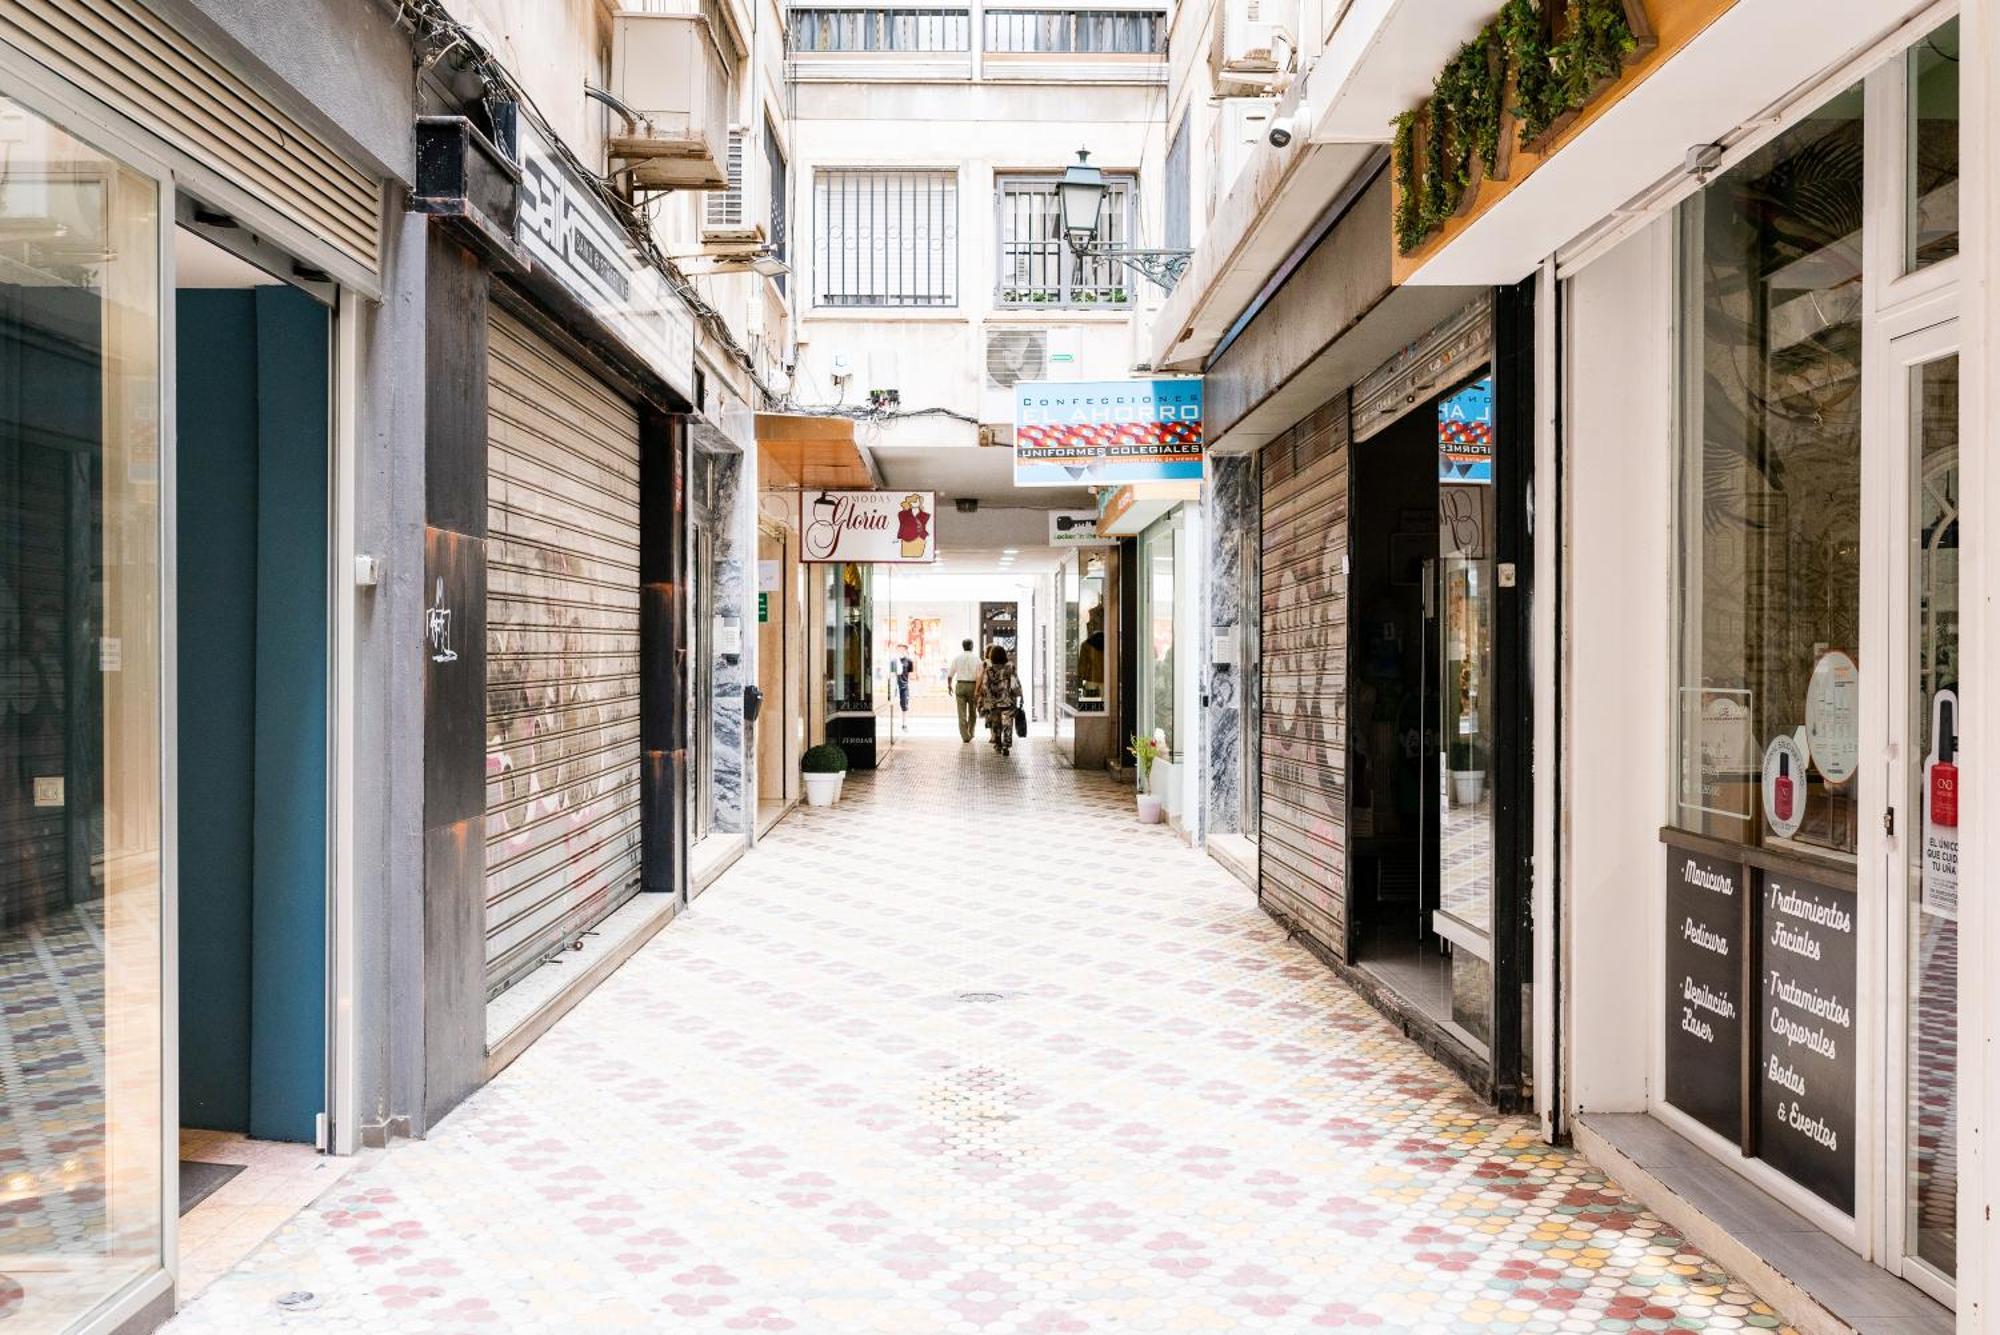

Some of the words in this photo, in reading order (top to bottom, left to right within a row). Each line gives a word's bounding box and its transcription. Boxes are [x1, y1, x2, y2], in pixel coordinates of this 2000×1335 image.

[1023, 408, 1055, 423] EL
[1071, 405, 1199, 422] AHORRO
[1022, 446, 1106, 457] UNIFORMES
[1111, 444, 1200, 455] COLEGIALES
[851, 494, 893, 503] MODAS
[806, 495, 889, 559] Gloria
[1927, 848, 1940, 859] QUE
[1929, 837, 1938, 847] EL
[1684, 859, 1734, 896] Manicura
[1932, 861, 1940, 871] TU
[1942, 862, 1957, 875] UÑA
[1770, 883, 1851, 933] Tratamientos
[1684, 917, 1729, 955] Pedicura
[1771, 921, 1821, 961] Faciales
[1770, 970, 1850, 1028] Tratamientos
[1682, 1006, 1714, 1043] Laser
[1770, 1007, 1836, 1059] Corporales
[1768, 1054, 1805, 1096] Bodas
[1777, 1102, 1787, 1122] &
[1789, 1102, 1837, 1151] Eventos
